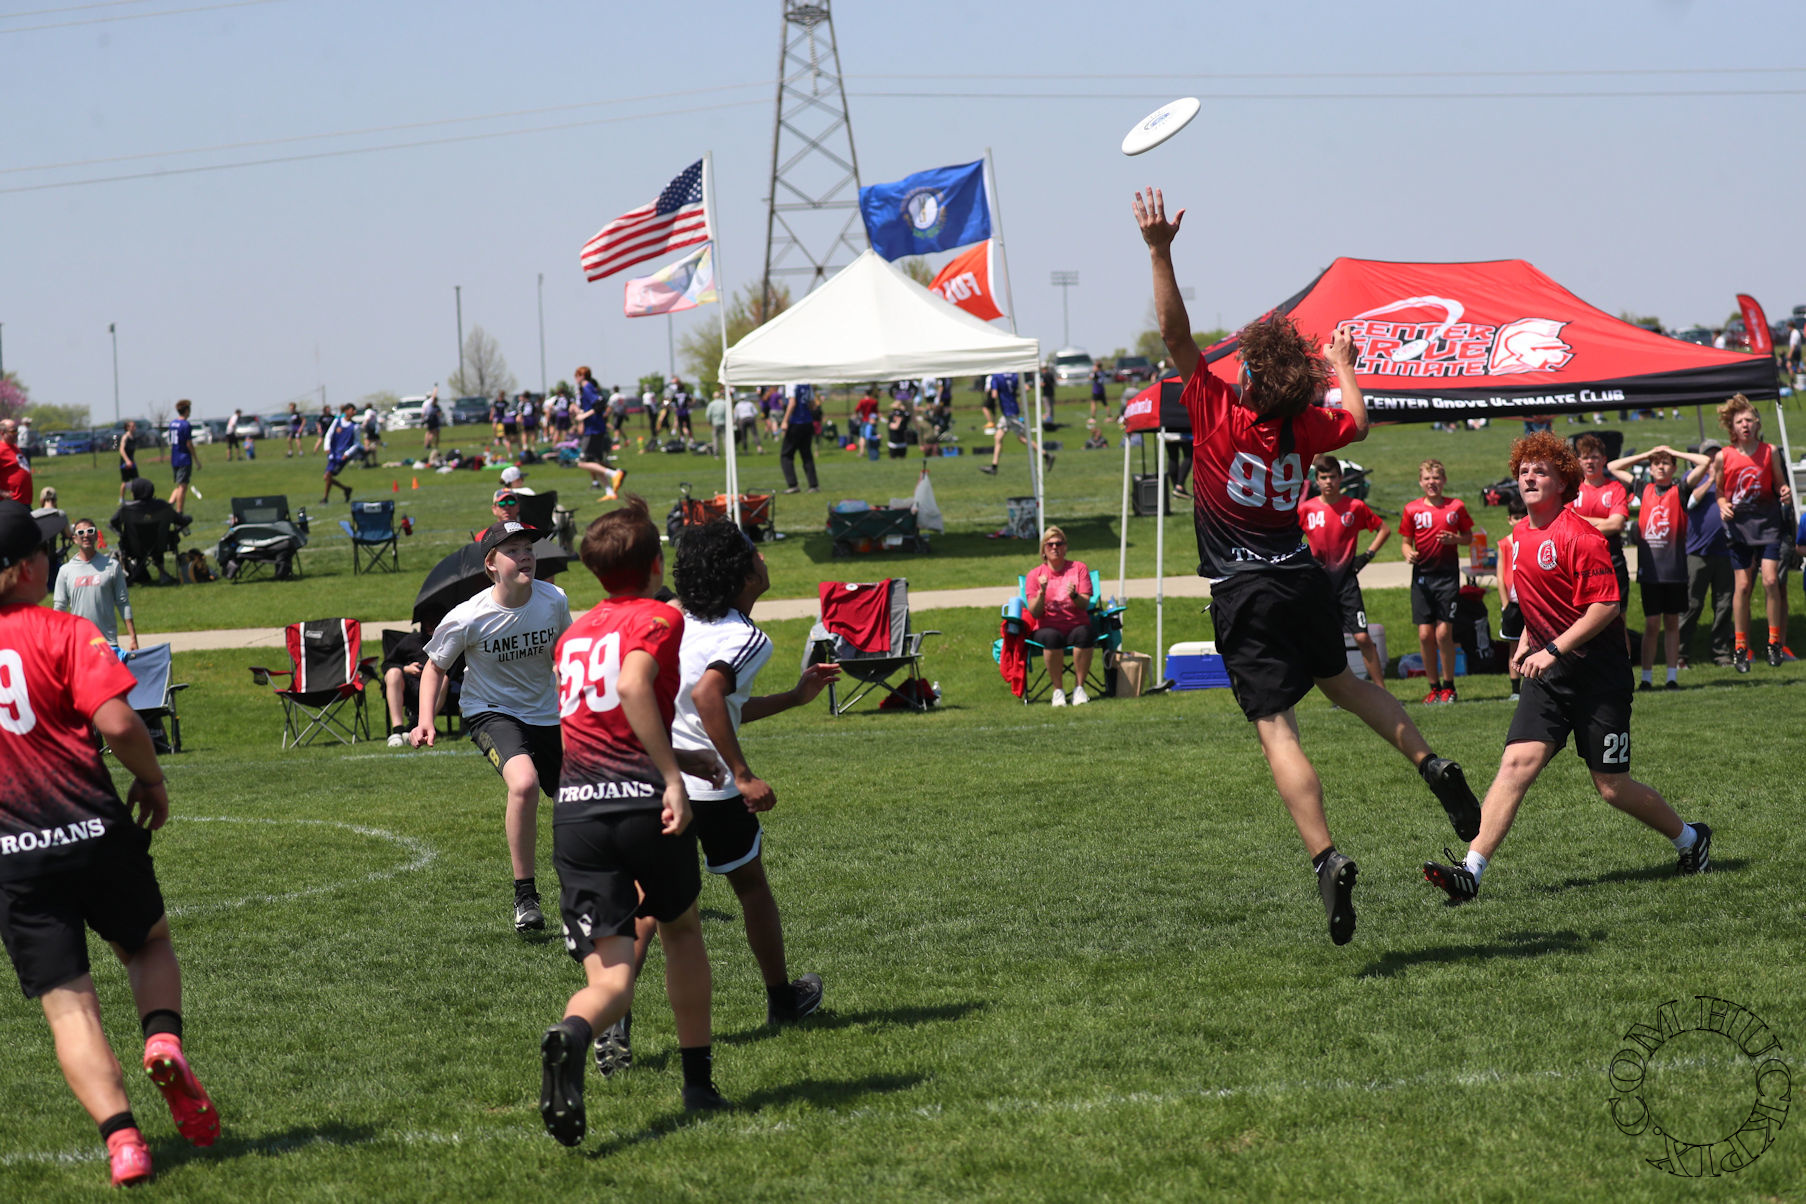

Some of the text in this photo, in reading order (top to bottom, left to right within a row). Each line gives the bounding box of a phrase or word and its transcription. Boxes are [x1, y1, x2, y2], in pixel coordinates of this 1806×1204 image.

[1353, 357, 1488, 377] LTIMATE
[1364, 395, 1428, 410] CENTER
[1579, 389, 1625, 403] CLUB
[1227, 452, 1304, 511] 89
[1307, 511, 1326, 530] 04
[1413, 511, 1433, 529] 20
[484, 627, 555, 654] LANE TECH
[498, 645, 545, 663] ULTIMATE
[559, 631, 621, 719] 59
[1602, 732, 1629, 764] 22
[558, 781, 655, 803] TROJANS
